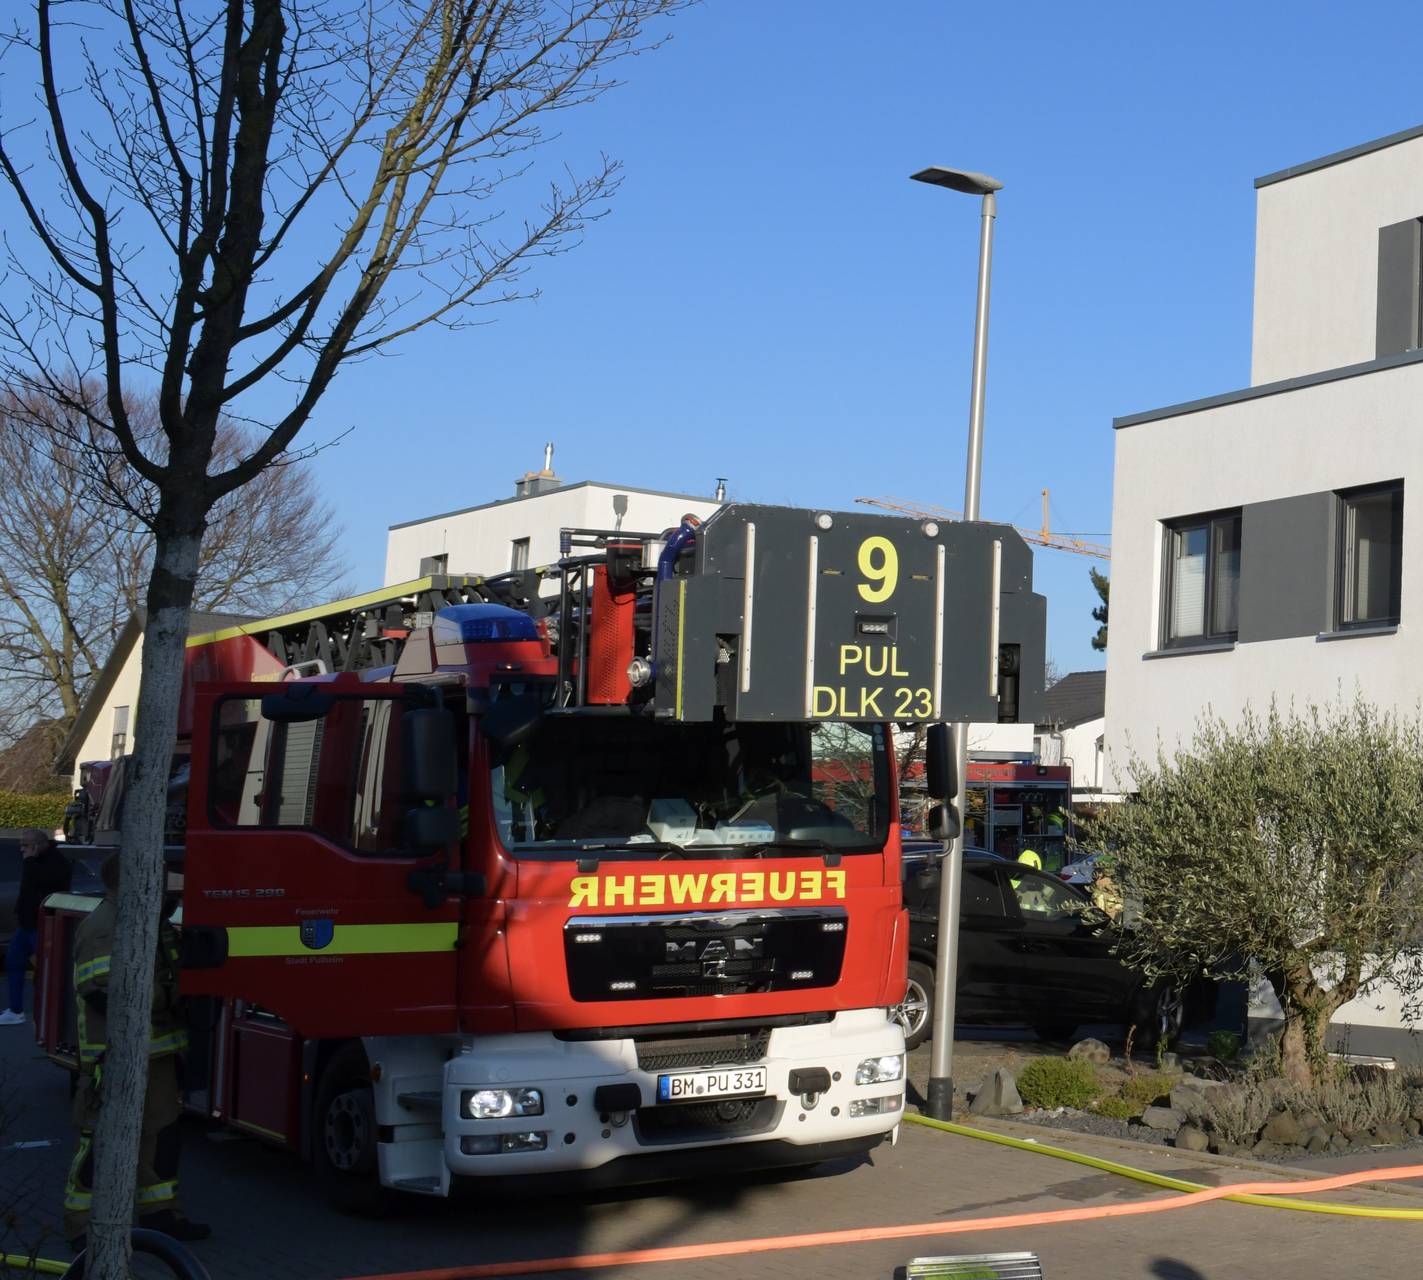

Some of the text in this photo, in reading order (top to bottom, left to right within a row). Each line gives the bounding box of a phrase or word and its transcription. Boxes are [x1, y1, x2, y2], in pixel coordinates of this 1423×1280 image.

[857, 535, 899, 604] 9
[839, 644, 910, 677] PUL
[812, 686, 933, 718] DLK 23
[665, 938, 764, 962] MAN
[671, 1071, 764, 1096] BM PU 331
